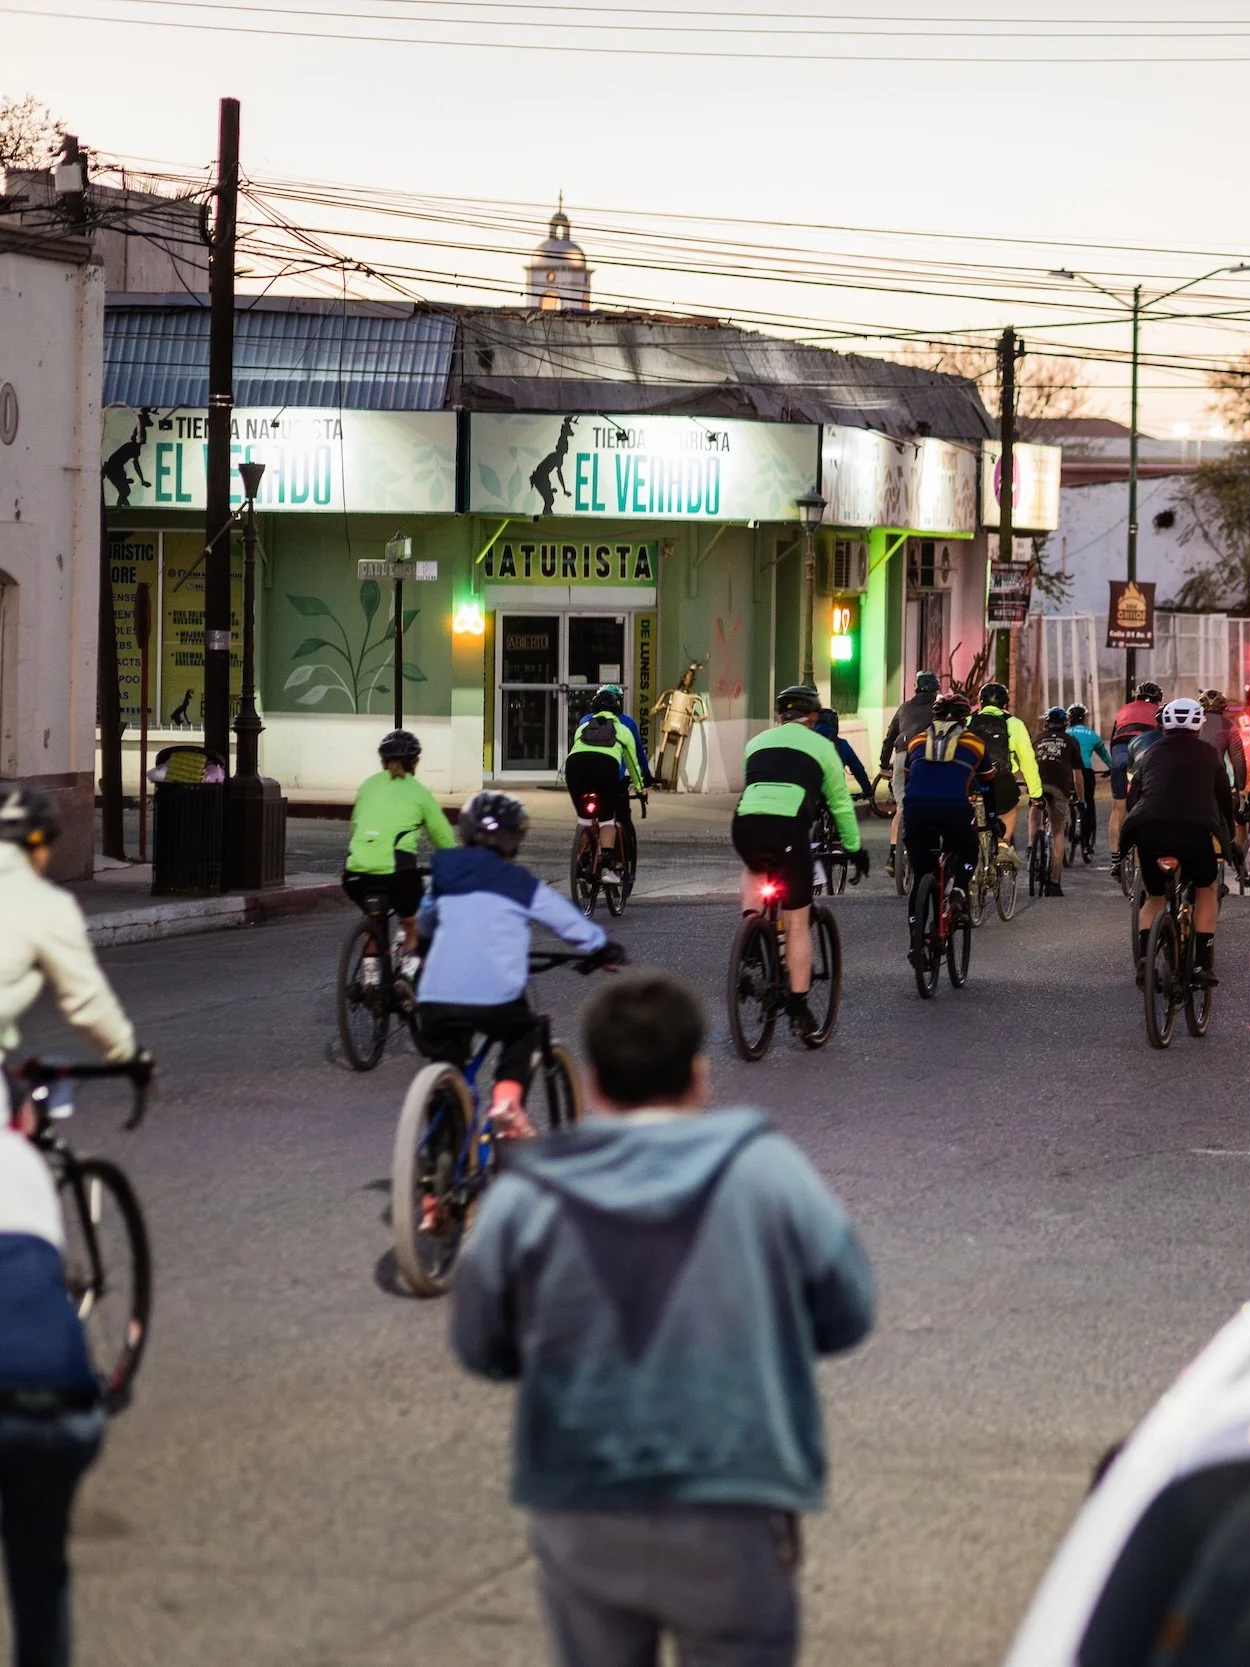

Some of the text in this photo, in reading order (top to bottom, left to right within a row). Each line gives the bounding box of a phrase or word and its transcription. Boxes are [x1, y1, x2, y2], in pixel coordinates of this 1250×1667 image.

[176, 417, 240, 439] TIEA
[155, 442, 192, 502] EL
[575, 453, 606, 511] EL
[362, 563, 395, 576] CALLE
[640, 618, 650, 638] DE
[640, 642, 650, 690] LUNES
[639, 694, 648, 704] A
